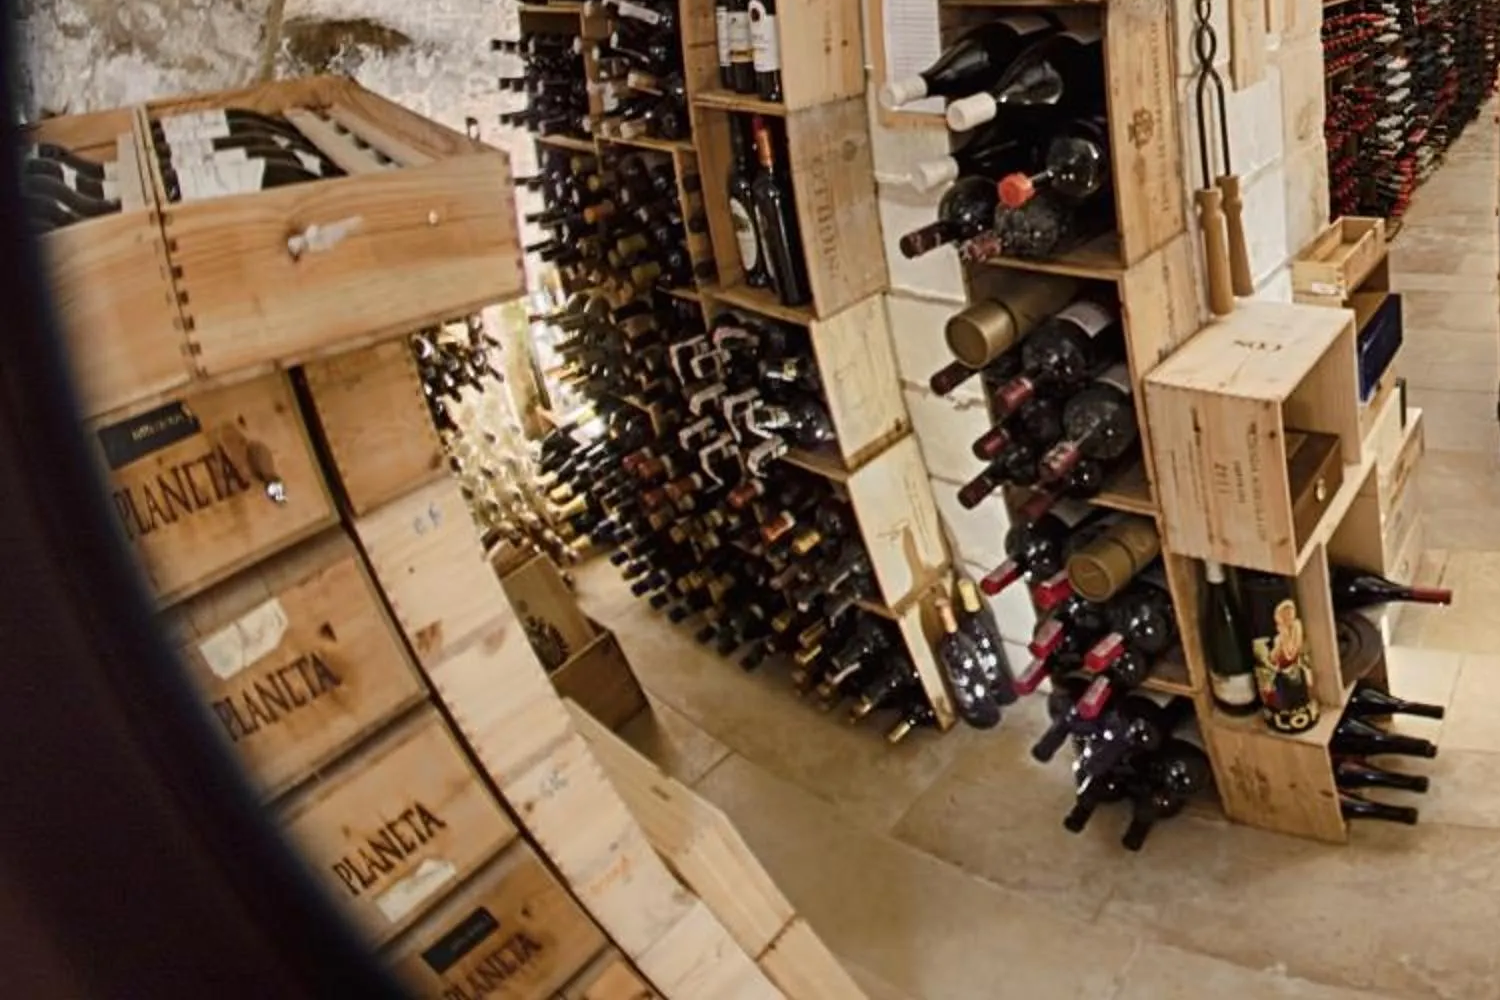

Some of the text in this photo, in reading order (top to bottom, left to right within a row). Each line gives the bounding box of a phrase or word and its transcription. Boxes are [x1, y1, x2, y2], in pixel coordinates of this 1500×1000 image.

[112, 443, 251, 541] PLANETA
[212, 650, 343, 743] PLANETA
[332, 800, 448, 897] PLANETA
